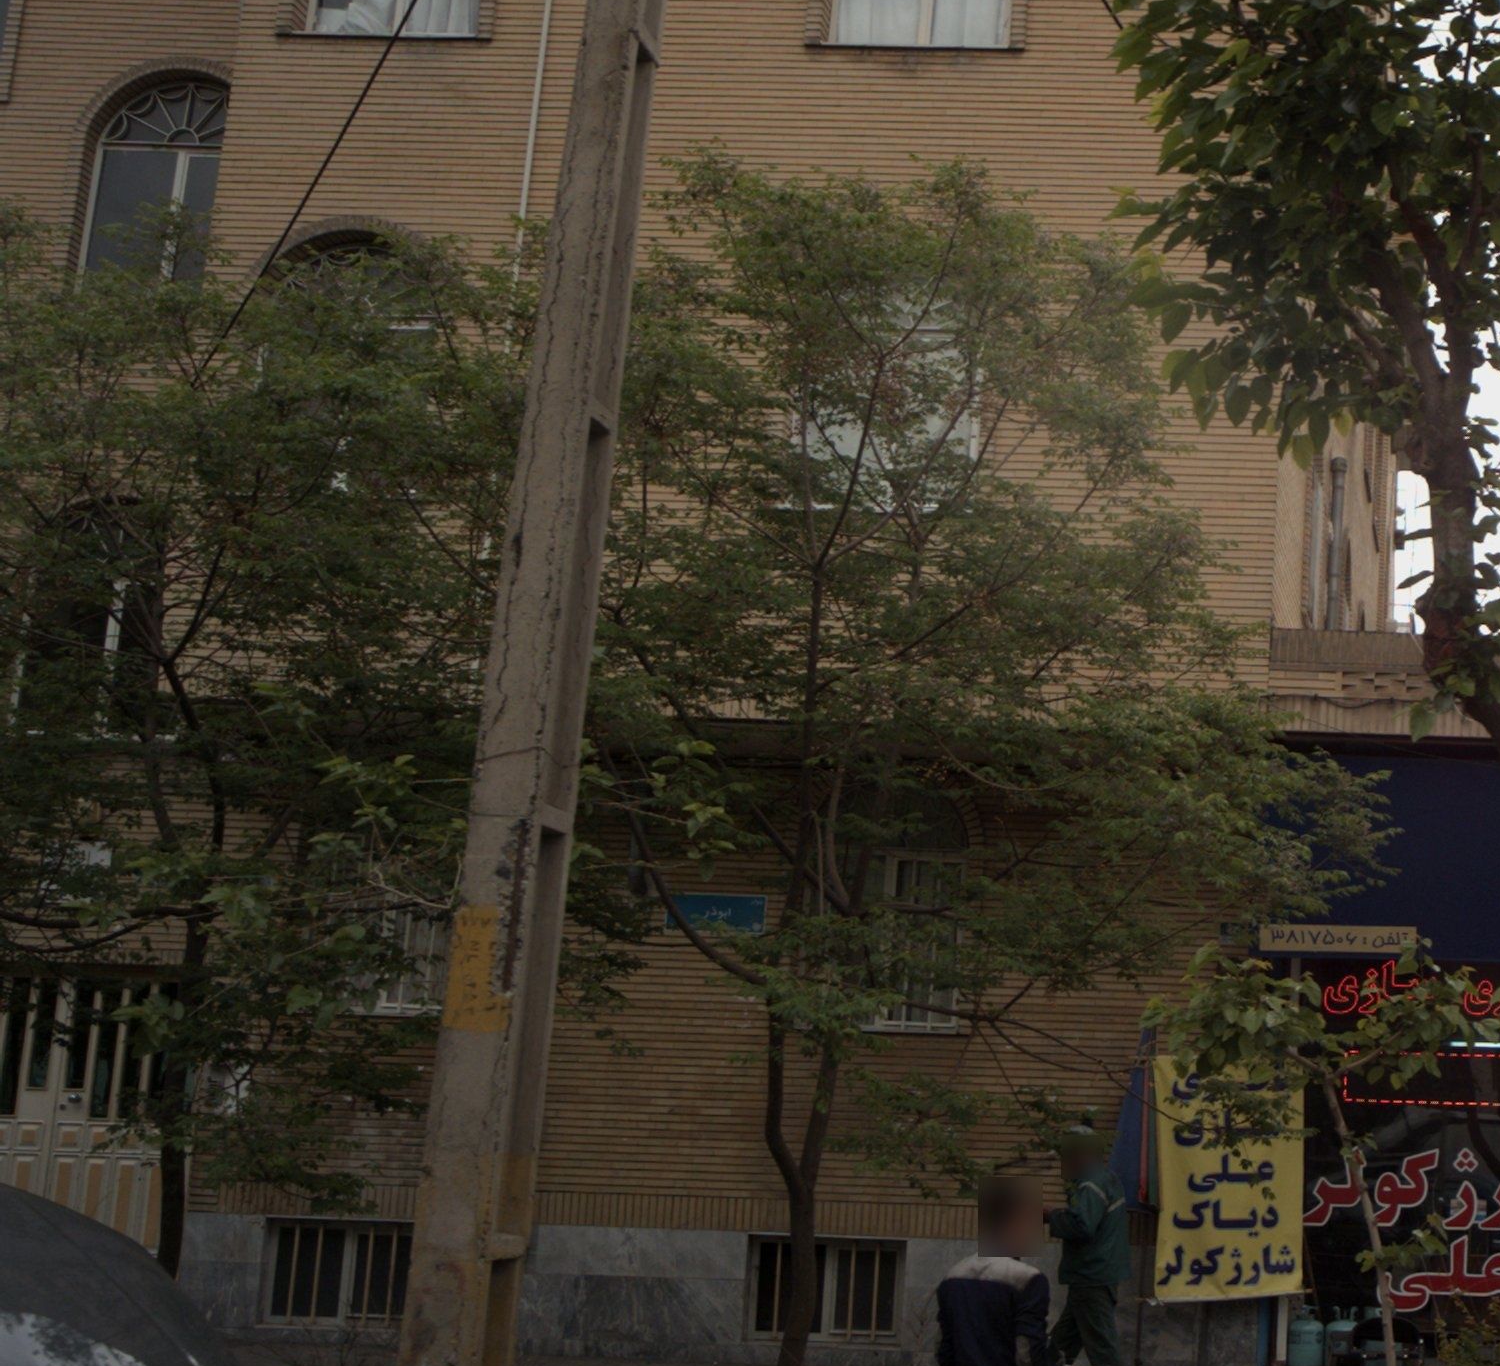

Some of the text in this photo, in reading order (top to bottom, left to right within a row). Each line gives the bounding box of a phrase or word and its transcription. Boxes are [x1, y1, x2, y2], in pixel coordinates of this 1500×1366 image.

[1271, 928, 1357, 946] ۳۸۱۷۵۰۶
[1187, 1154, 1274, 1193] علی
[1303, 1145, 1441, 1227] کولر
[1157, 1243, 1296, 1286] شارژ کولر
